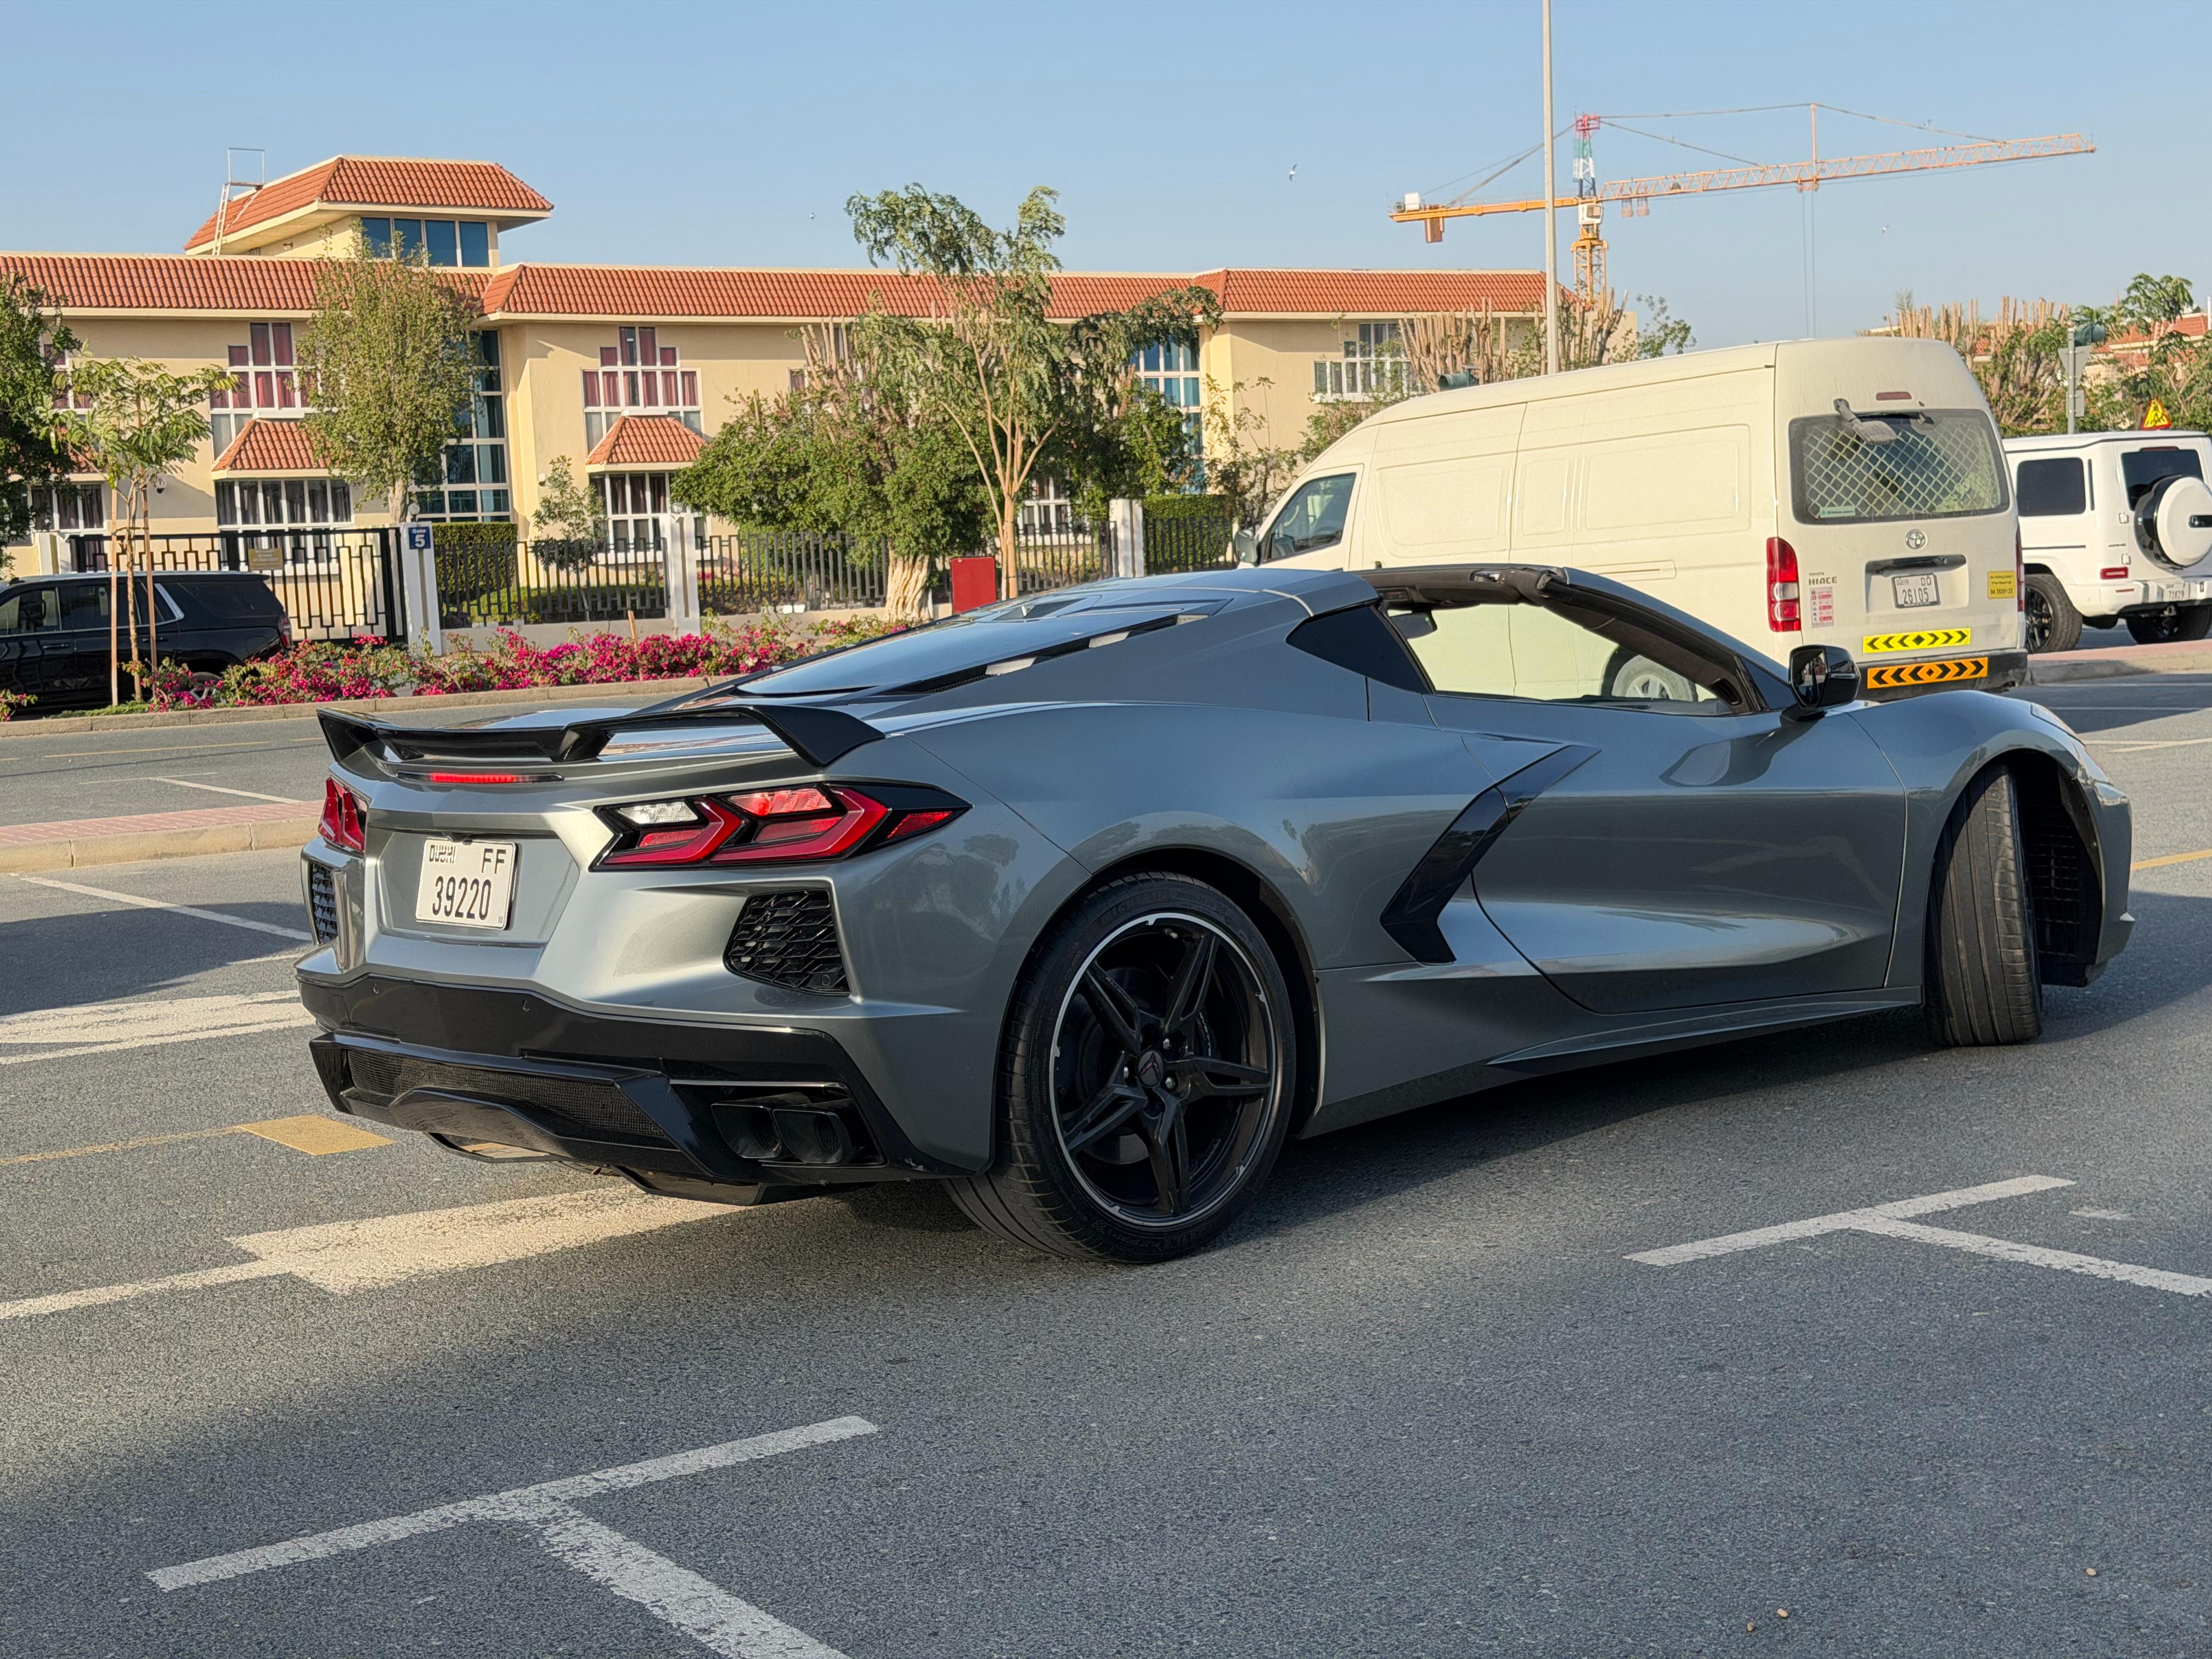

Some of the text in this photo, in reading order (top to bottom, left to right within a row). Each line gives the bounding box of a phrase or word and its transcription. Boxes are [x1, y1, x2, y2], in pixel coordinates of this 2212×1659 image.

[415, 534, 425, 548] 5
[1808, 576, 1837, 586] HIACE
[1902, 587, 1929, 605] 26105
[481, 848, 506, 874] FF
[432, 876, 492, 921] 39220
